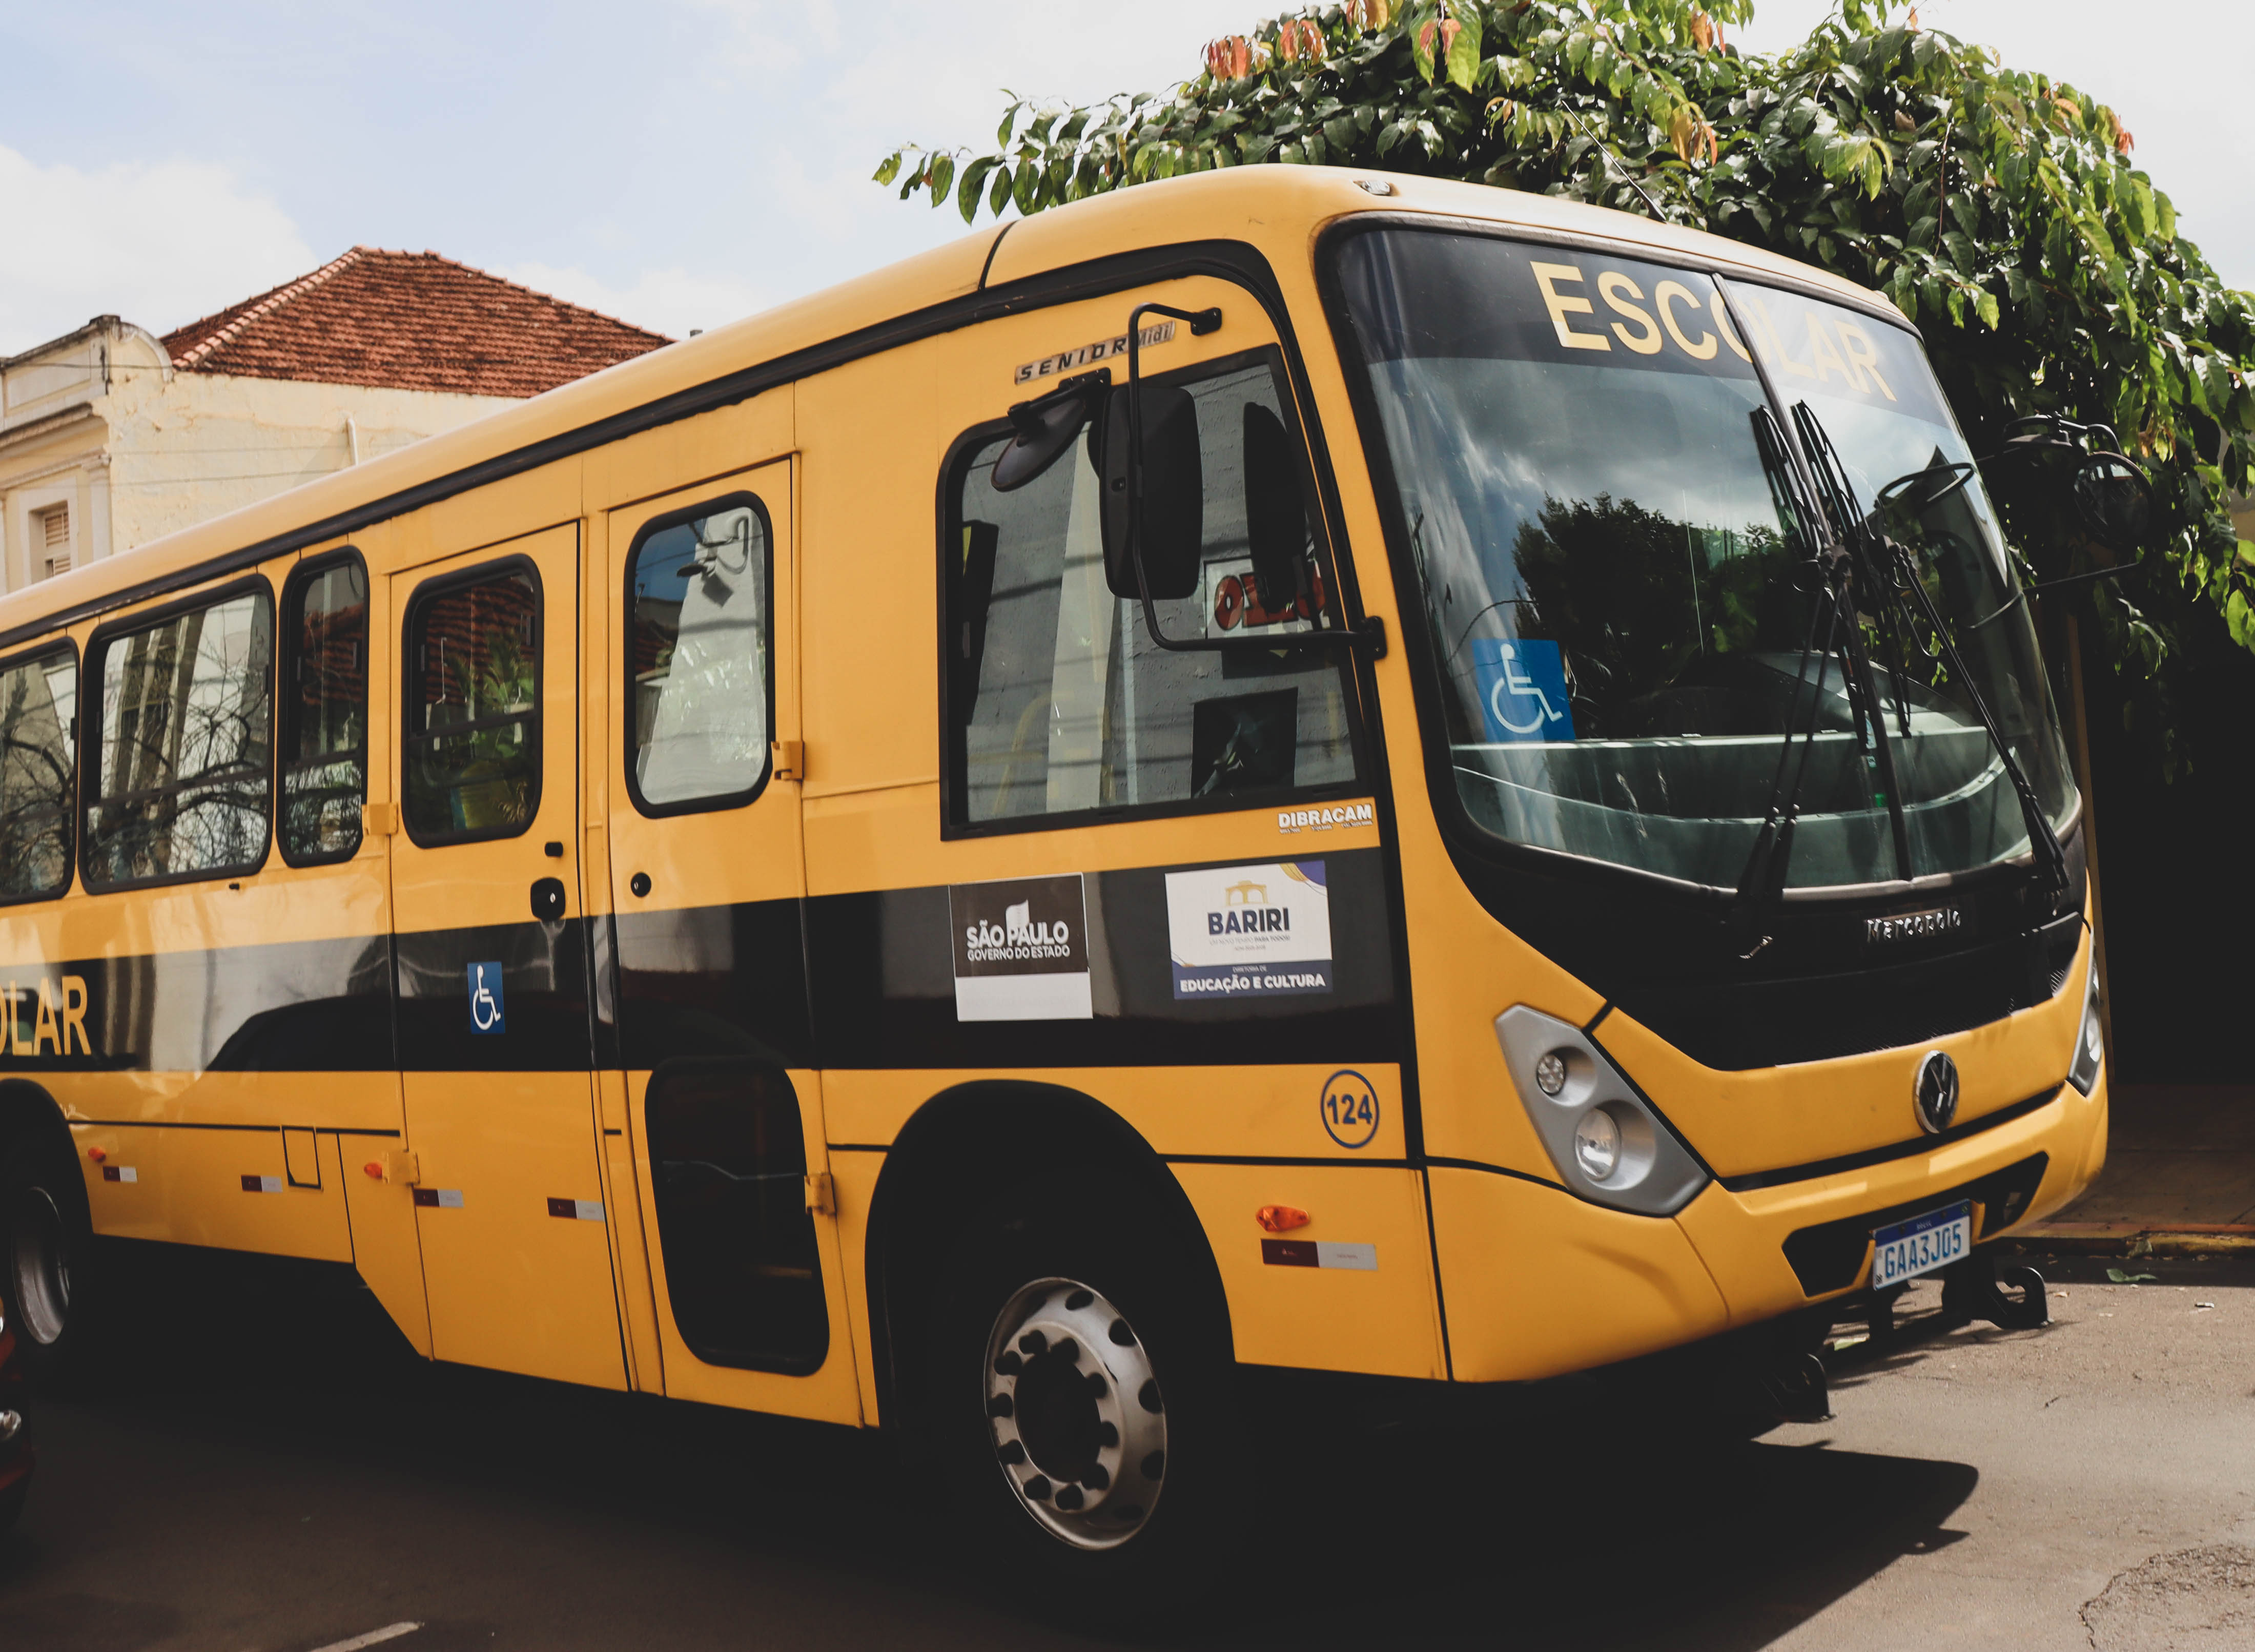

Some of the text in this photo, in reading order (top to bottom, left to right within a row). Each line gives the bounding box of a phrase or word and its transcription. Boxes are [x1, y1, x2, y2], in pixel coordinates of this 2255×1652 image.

[1529, 260, 1897, 401] ESCOLAR
[1019, 336, 1127, 381] SENIOR
[1278, 803, 1372, 829] DIBRACAM
[967, 919, 1069, 948] SÃO PAULO
[1207, 907, 1290, 936] BARIRI
[967, 944, 1071, 961] GOVERNO DO ESTADO
[1180, 973, 1326, 994] EDUCAÇÃO E CULTURA
[1327, 1093, 1373, 1125] 124
[1884, 1222, 1962, 1278] GAA3J05
